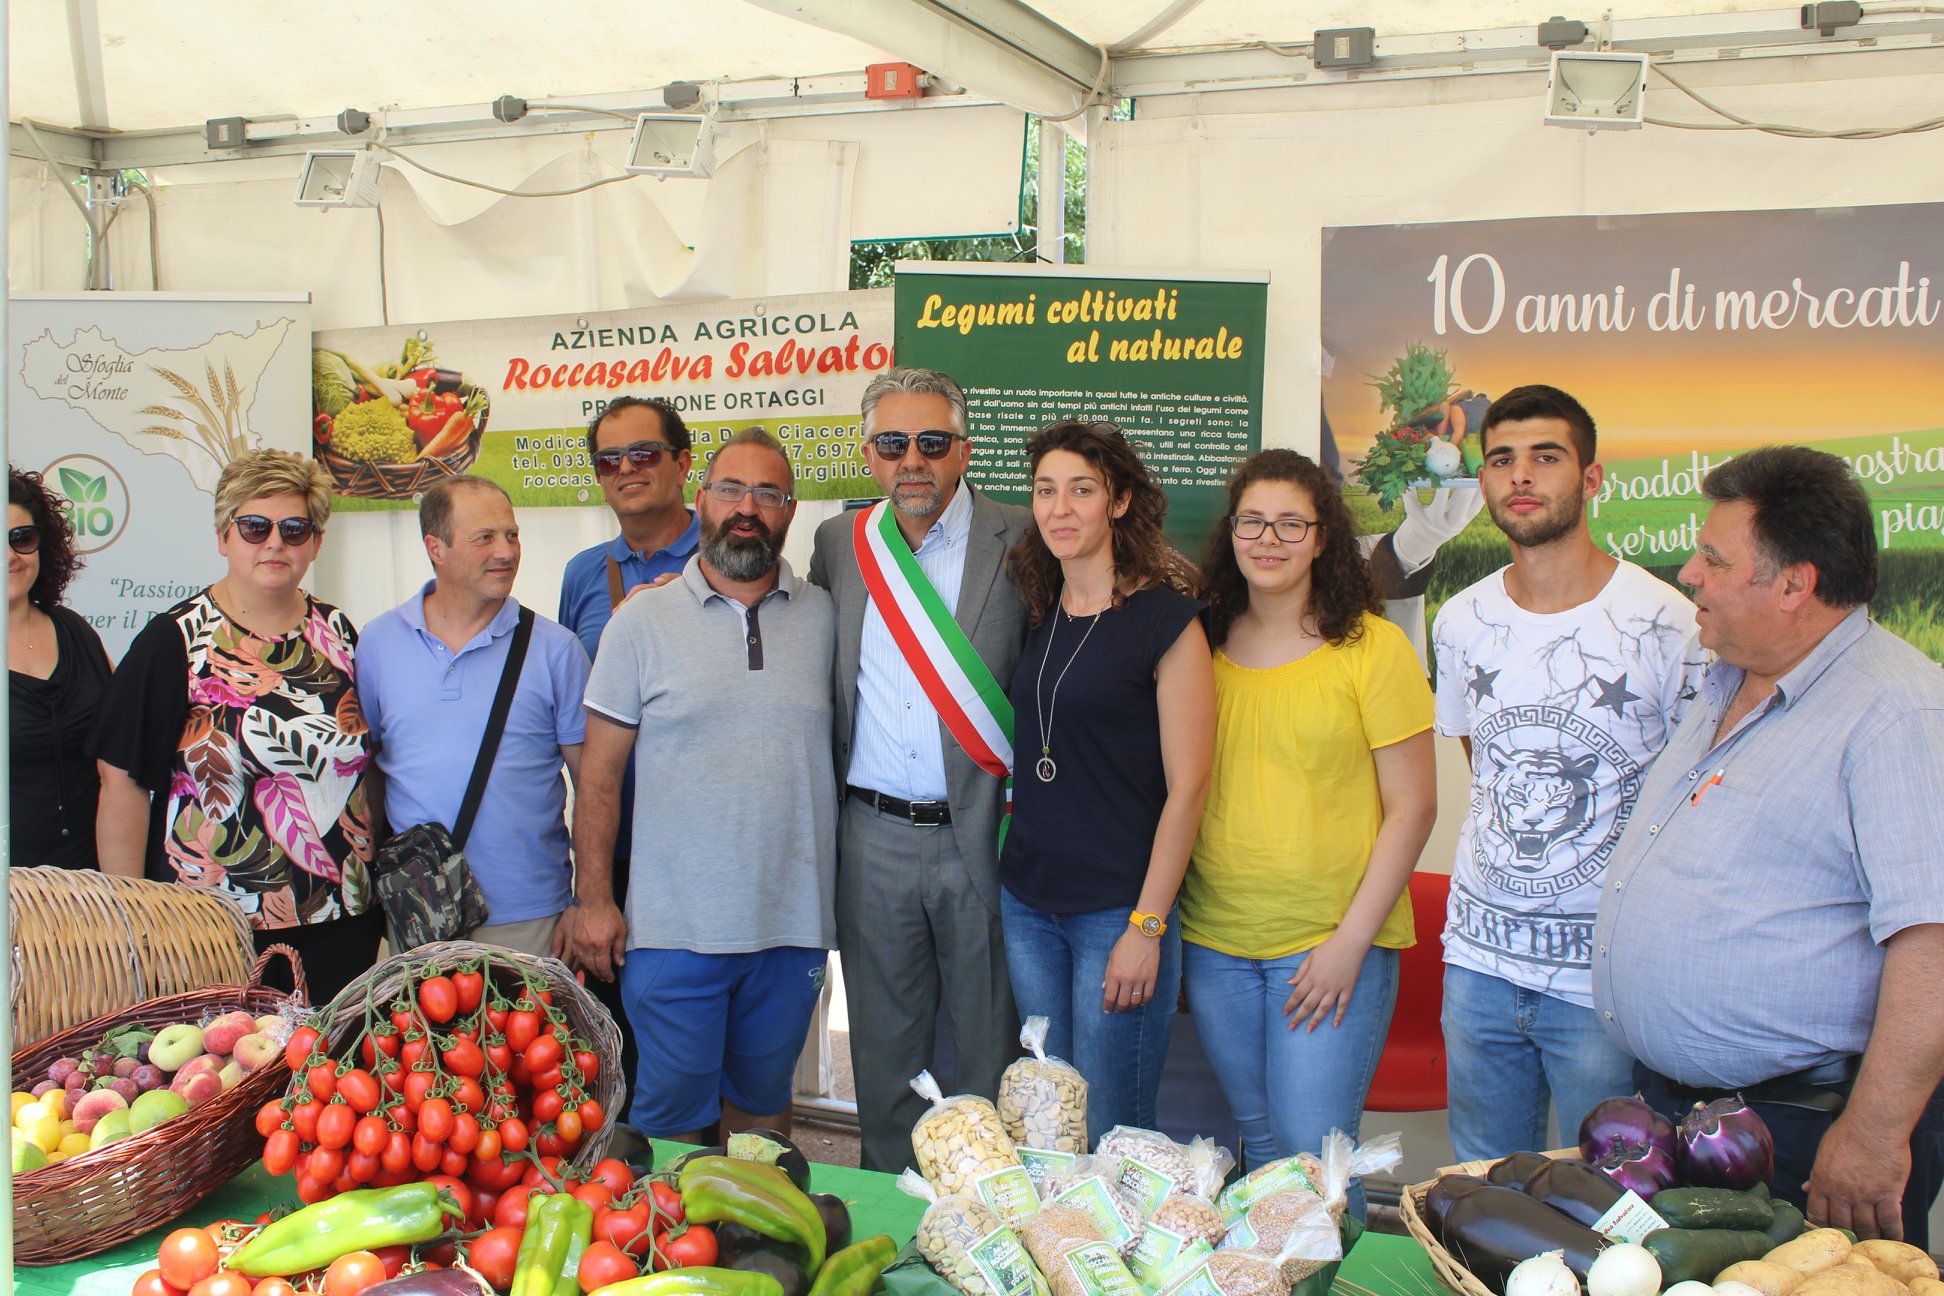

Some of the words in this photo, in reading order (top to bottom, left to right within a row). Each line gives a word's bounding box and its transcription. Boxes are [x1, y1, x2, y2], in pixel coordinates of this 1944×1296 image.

[1427, 253, 1506, 335] 10
[1515, 285, 1635, 333] anni
[1647, 267, 1706, 333] di
[1715, 261, 1941, 329] mercati
[917, 293, 1037, 335] Legumi
[1047, 288, 1179, 324] coltivati
[551, 325, 678, 350] AZIENDA
[694, 311, 859, 341] AGRICOLA
[1067, 329, 1100, 363] al
[1109, 326, 1244, 361] naturale
[65, 353, 135, 379] Sfoglia
[503, 347, 713, 390] Roccasalva
[67, 381, 128, 401] Monte
[724, 389, 824, 410] ORTAGGI
[1039, 389, 1082, 398] importante
[1085, 390, 1092, 398] in
[1095, 390, 1117, 399] quasi
[1151, 392, 1181, 401] antiche
[1184, 394, 1211, 402] culture
[1058, 402, 1081, 410] tempi
[1193, 406, 1222, 415] legumi
[968, 411, 991, 419] base
[997, 412, 1024, 420] risale
[1168, 418, 1202, 426] segreti
[979, 423, 996, 431] loro
[1000, 424, 1038, 432] immenso
[1201, 430, 1222, 438] ricca
[516, 436, 587, 451] Modica
[1194, 442, 1230, 451] controllo
[513, 455, 546, 468] tel.
[1196, 466, 1217, 475] Oggi
[984, 483, 1010, 491] anche
[1607, 513, 1704, 560] servit
[123, 609, 137, 629] il
